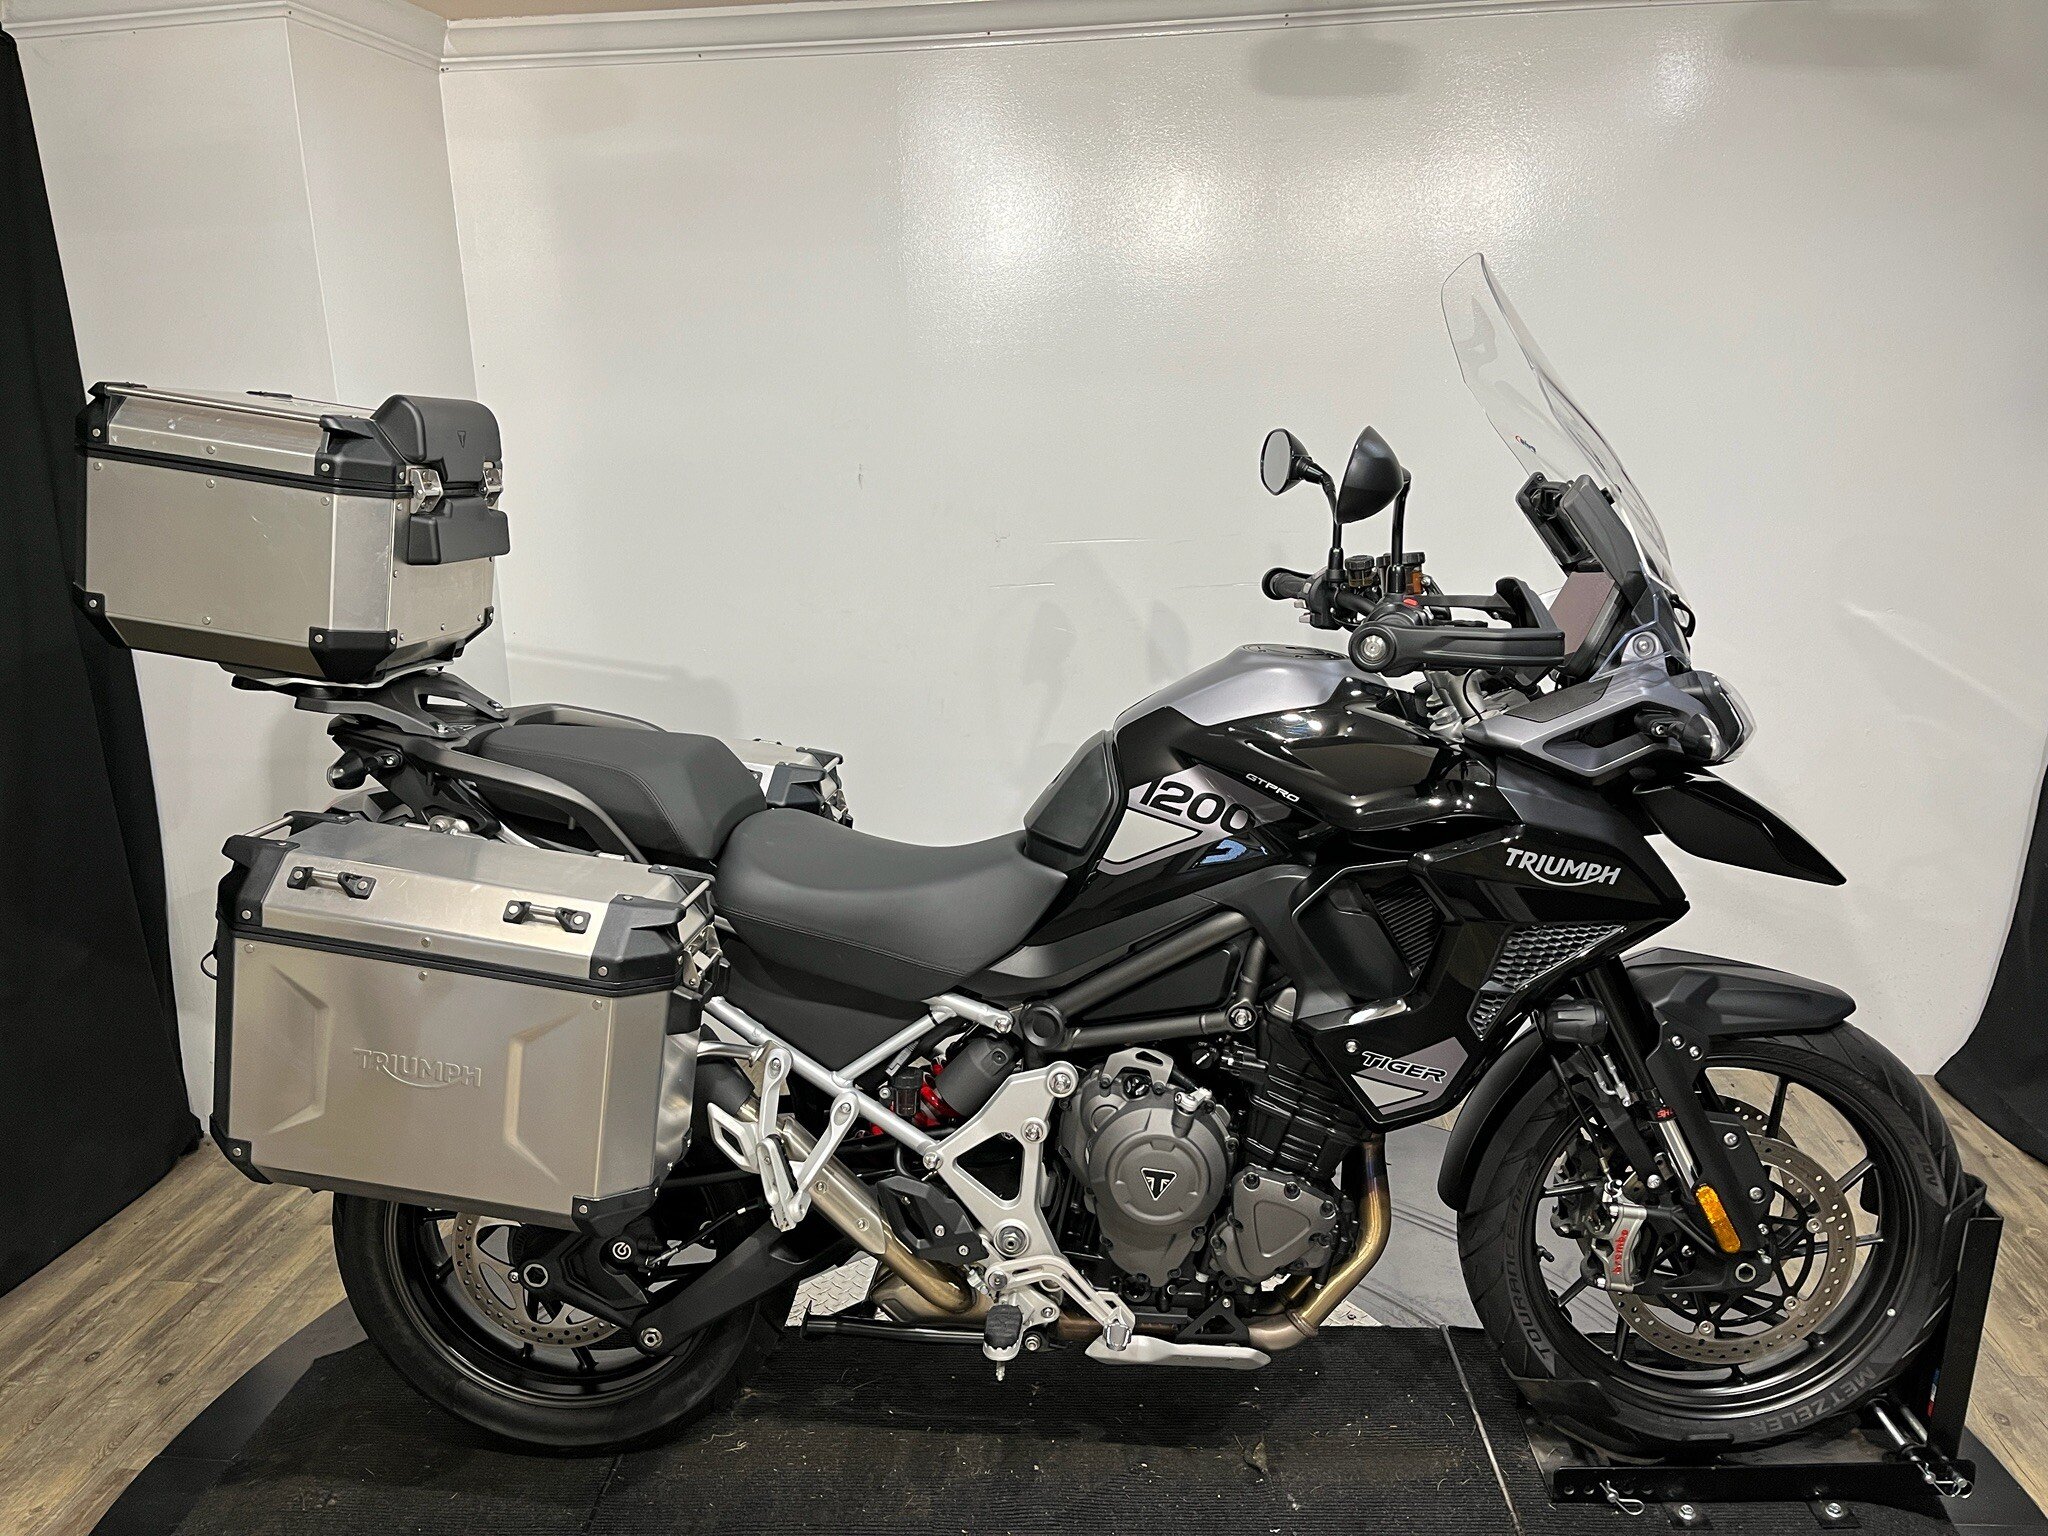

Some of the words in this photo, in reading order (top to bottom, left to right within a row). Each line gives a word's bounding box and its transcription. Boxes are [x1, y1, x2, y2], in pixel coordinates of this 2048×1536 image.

[1139, 777, 1256, 835] 1200
[1505, 847, 1621, 887] TRIUMPH
[353, 1047, 482, 1088] TRIUMPH
[1361, 1050, 1448, 1084] TIGER
[1612, 1228, 1629, 1276] brembo
[1504, 1221, 1552, 1361] TOURANCE
[1749, 1365, 1879, 1435] METZELER
